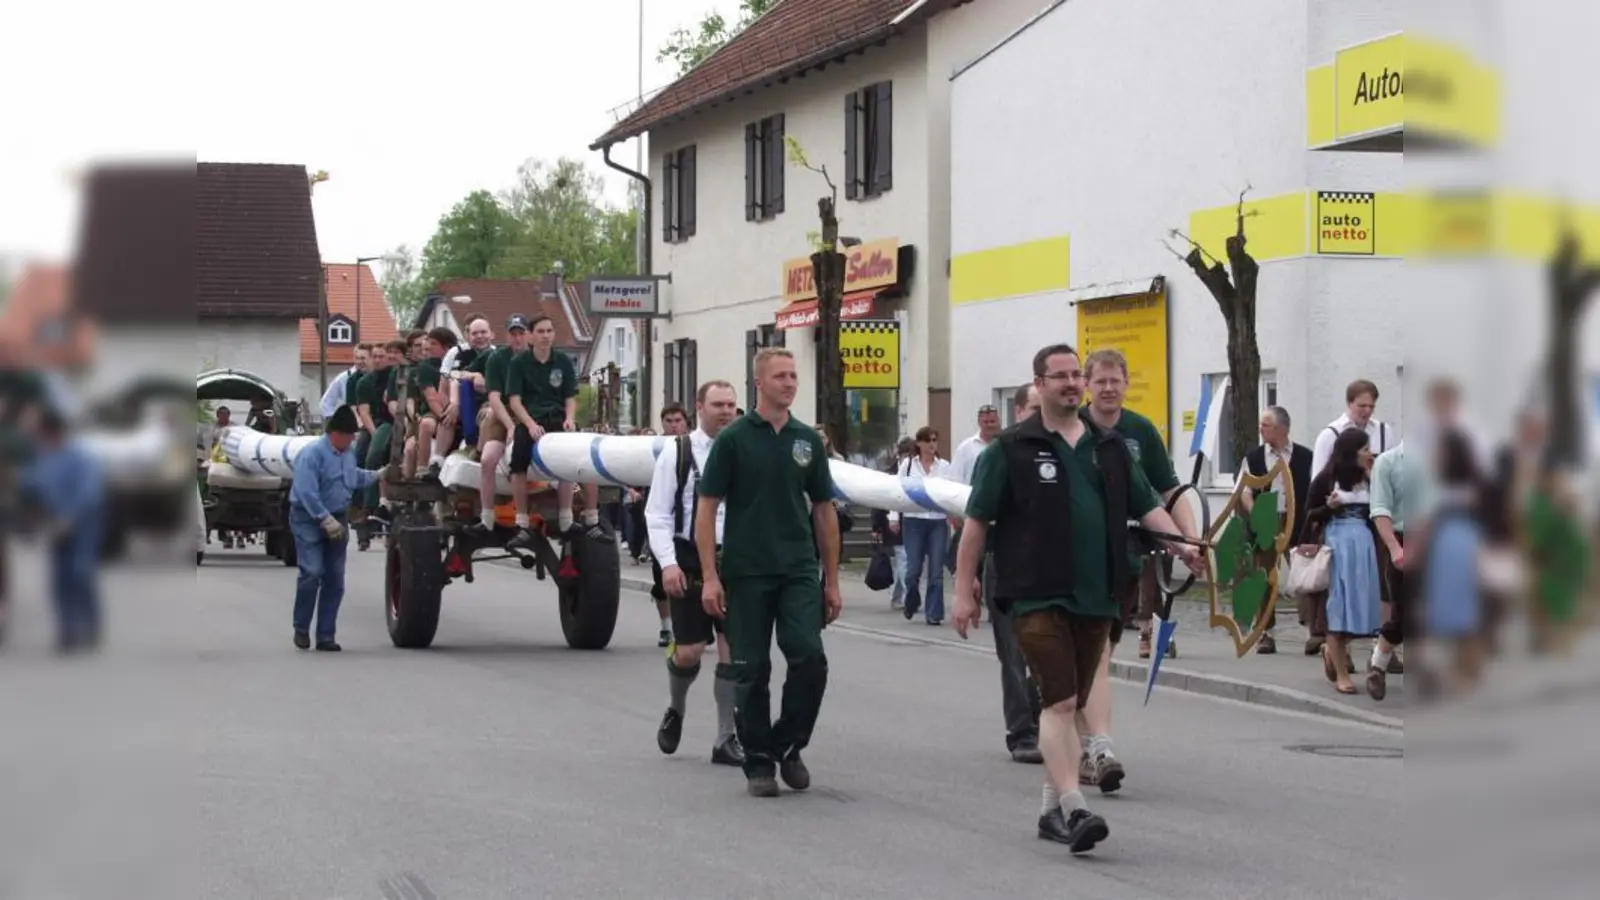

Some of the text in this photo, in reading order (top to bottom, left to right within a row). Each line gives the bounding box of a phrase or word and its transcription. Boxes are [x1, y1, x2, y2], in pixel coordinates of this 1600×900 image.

[1354, 68, 1403, 105] Auto
[1322, 213, 1361, 226] auto
[1322, 227, 1367, 240] netto
[594, 284, 652, 296] Metzgerei
[840, 345, 885, 358] auto
[842, 360, 892, 374] netto
